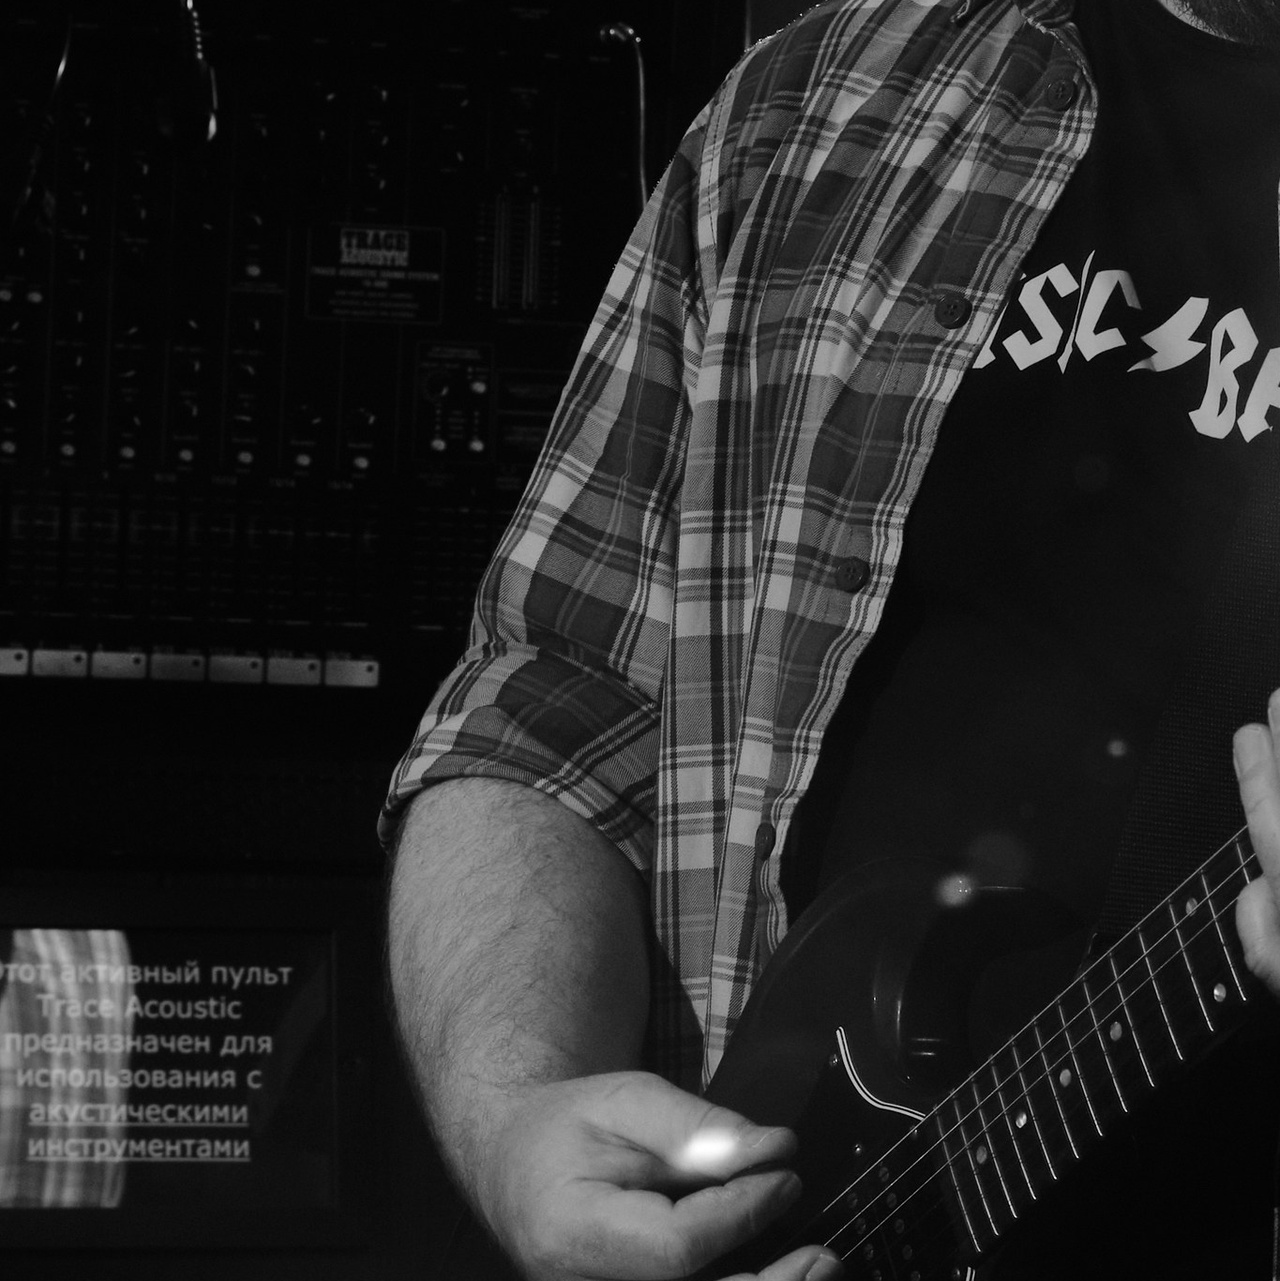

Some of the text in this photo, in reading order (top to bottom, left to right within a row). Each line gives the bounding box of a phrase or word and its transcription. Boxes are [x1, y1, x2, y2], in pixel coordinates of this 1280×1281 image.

[61, 960, 200, 985] активный
[211, 965, 293, 990] пульт
[36, 993, 242, 1020] Trace Acoustic
[4, 1032, 273, 1058] предназначен для
[16, 1068, 263, 1089] использования с
[28, 1102, 249, 1126] акустическими
[27, 1137, 250, 1162] инструментами
